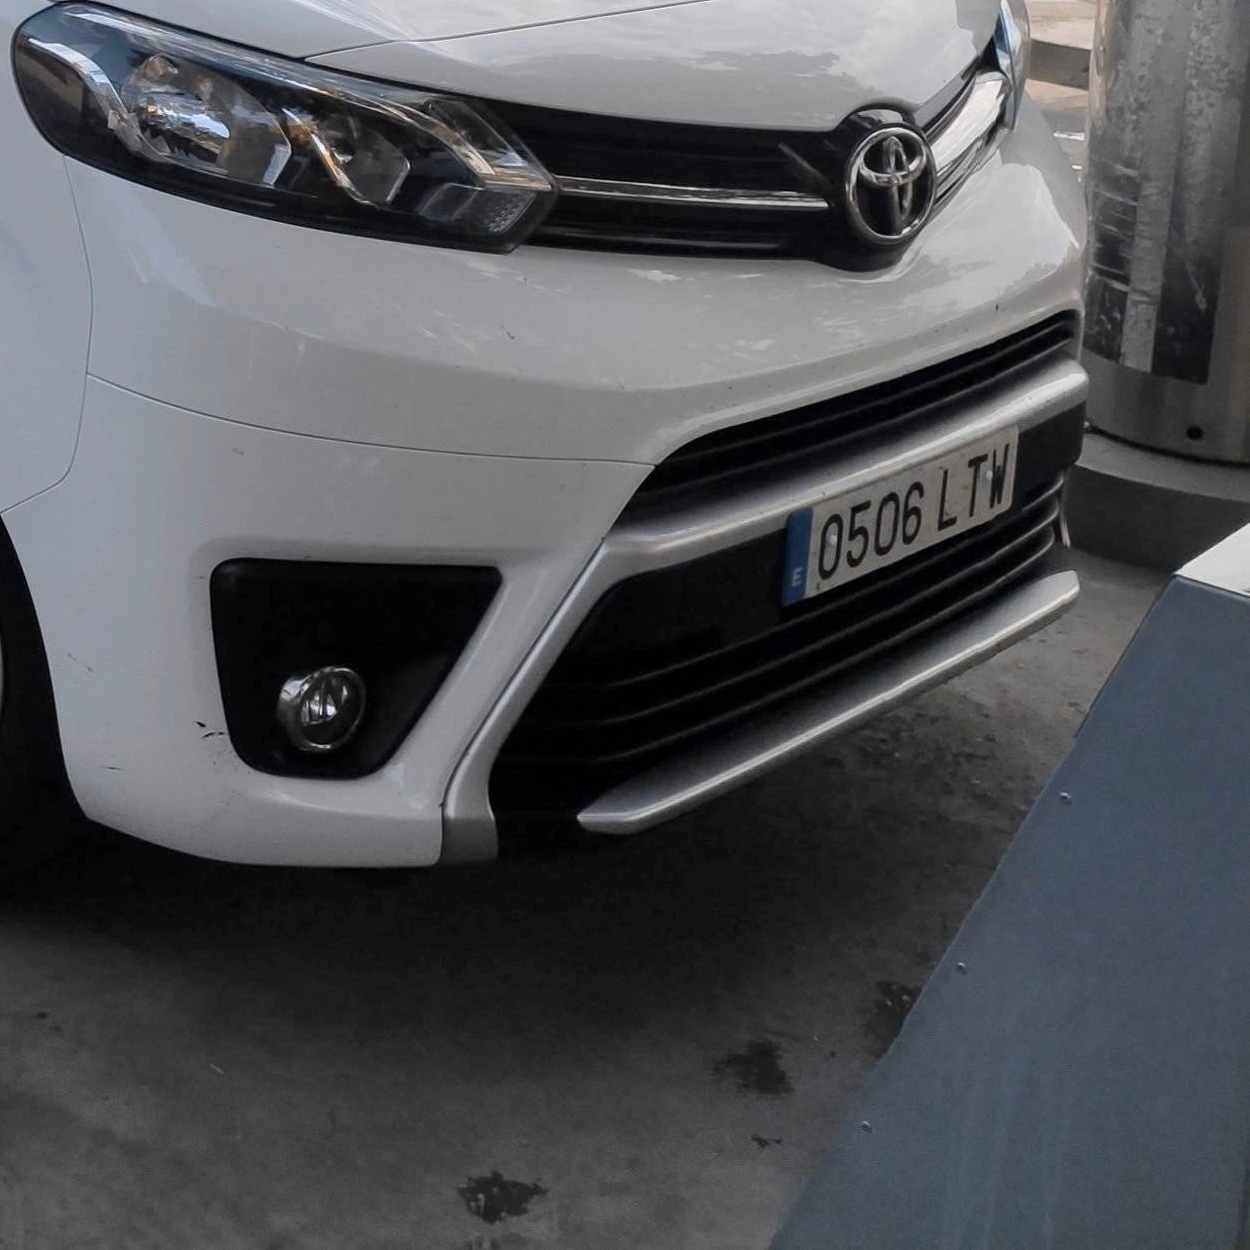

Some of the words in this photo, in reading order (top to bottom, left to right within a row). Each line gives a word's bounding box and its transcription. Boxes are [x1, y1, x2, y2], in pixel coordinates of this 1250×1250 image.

[818, 481, 925, 580] 0506
[937, 443, 1010, 531] LTW
[792, 566, 804, 587] E
